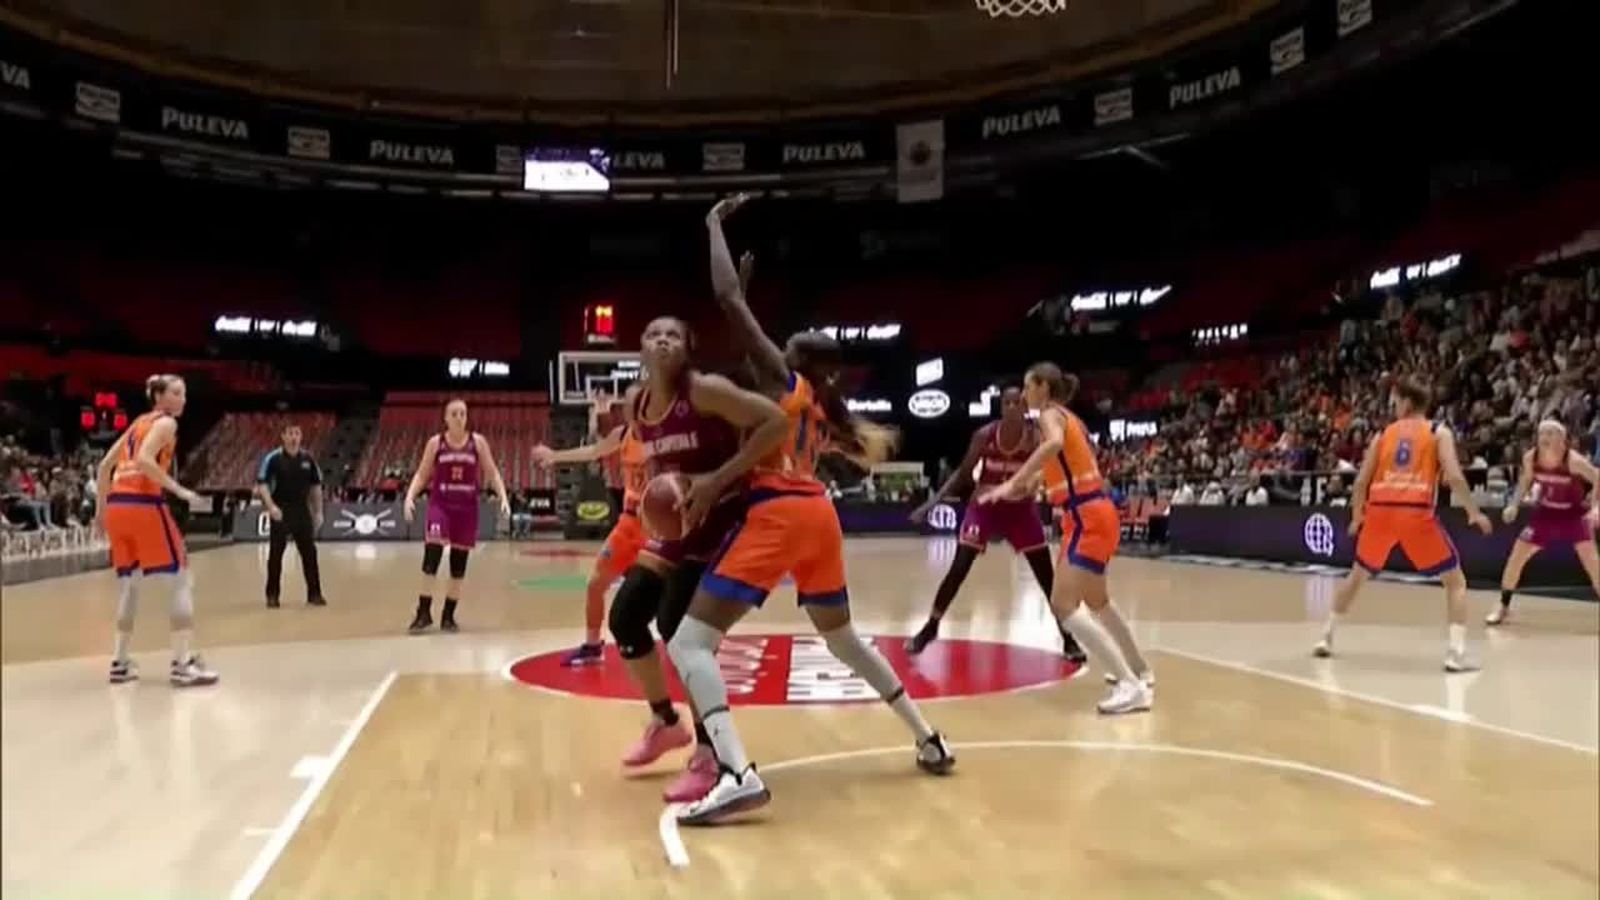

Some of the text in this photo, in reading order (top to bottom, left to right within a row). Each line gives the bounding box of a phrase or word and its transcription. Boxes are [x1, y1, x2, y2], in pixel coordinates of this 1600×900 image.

[1170, 67, 1241, 108] PULEVA
[162, 107, 249, 140] PULEVA
[982, 106, 1061, 138] PULEVA
[370, 140, 454, 165] PULEVA
[784, 142, 864, 163] PULEVA
[1395, 439, 1411, 466] 6
